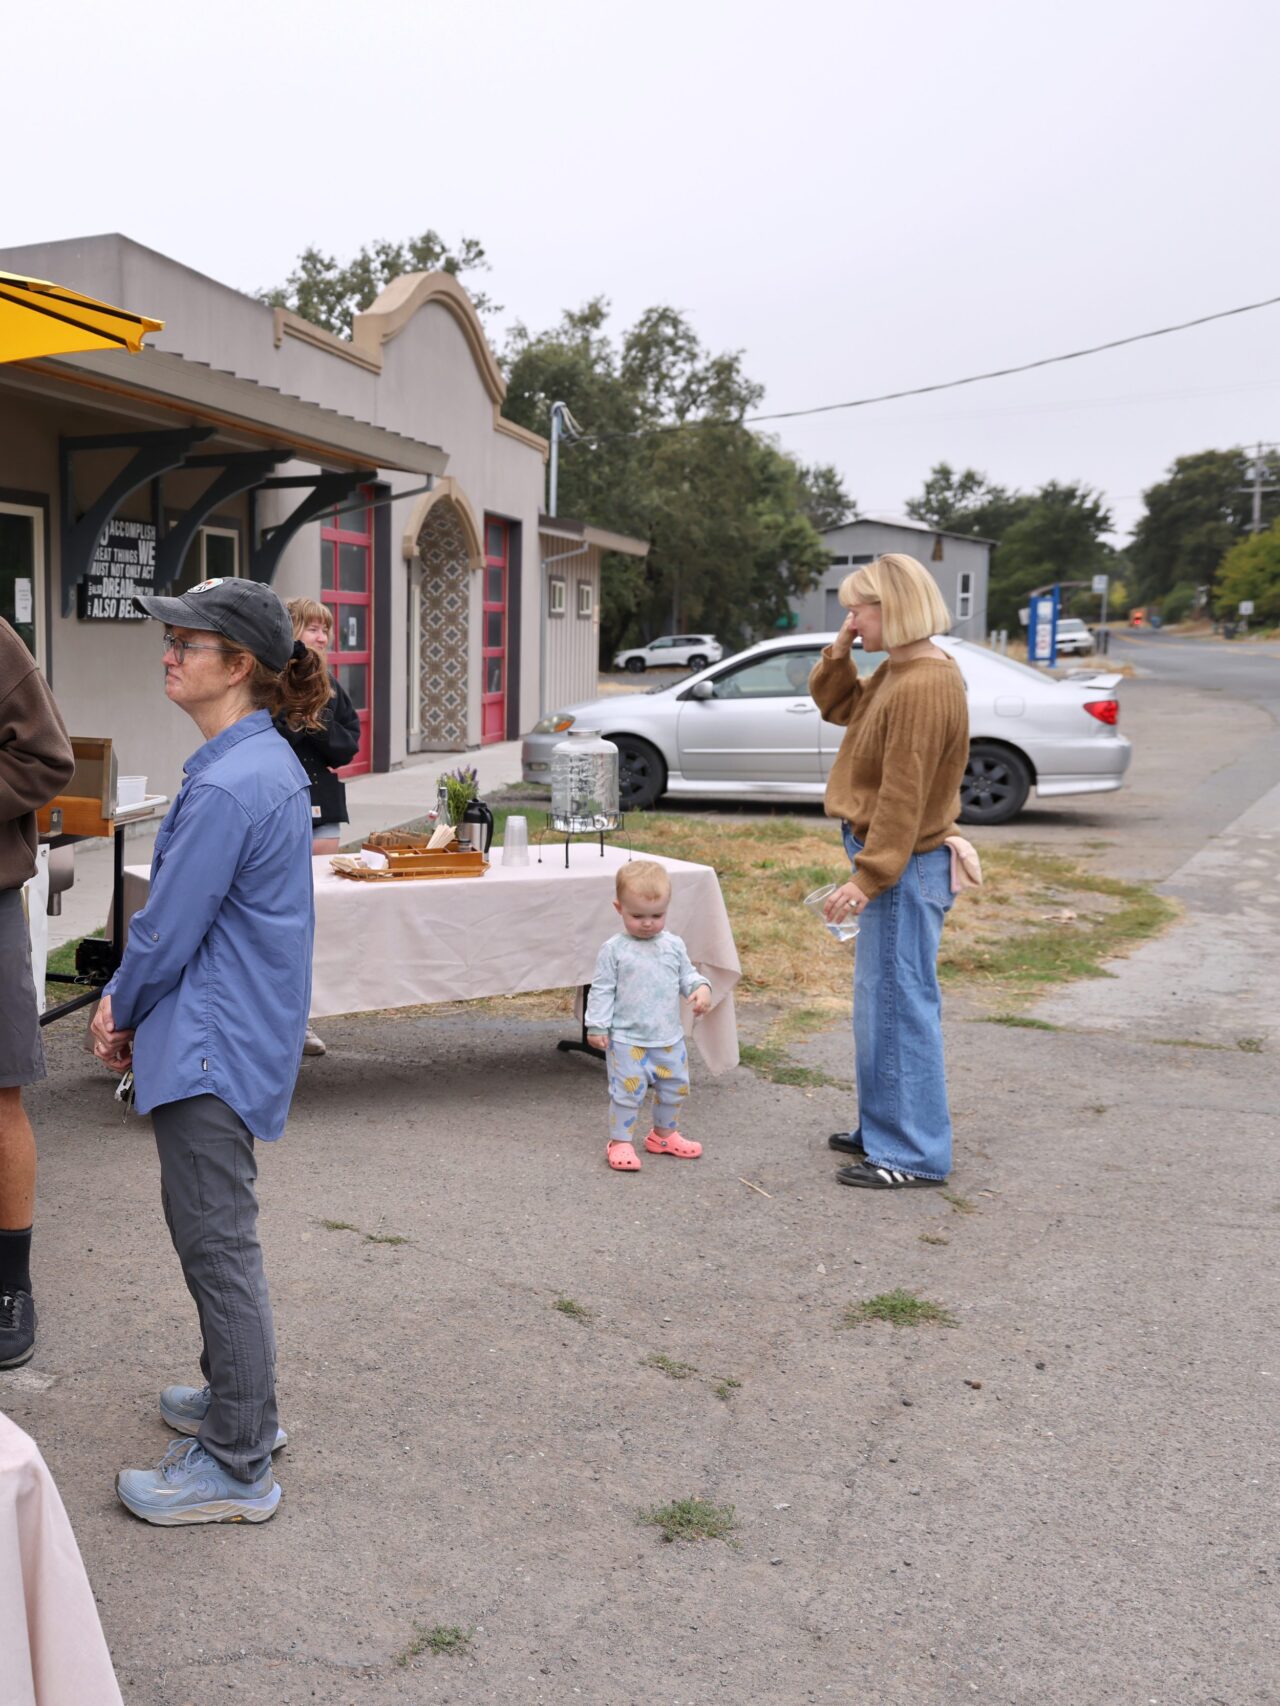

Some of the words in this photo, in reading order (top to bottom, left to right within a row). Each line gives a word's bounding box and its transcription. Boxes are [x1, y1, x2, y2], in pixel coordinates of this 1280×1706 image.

[110, 520, 155, 540] ACCOMPLISH
[113, 547, 138, 564] THINGS
[138, 539, 156, 566] WE
[110, 562, 125, 578] NOT
[125, 563, 141, 579] ONLY
[141, 565, 155, 580] ACT
[102, 577, 134, 599] DREAM
[92, 598, 118, 618] ALSO
